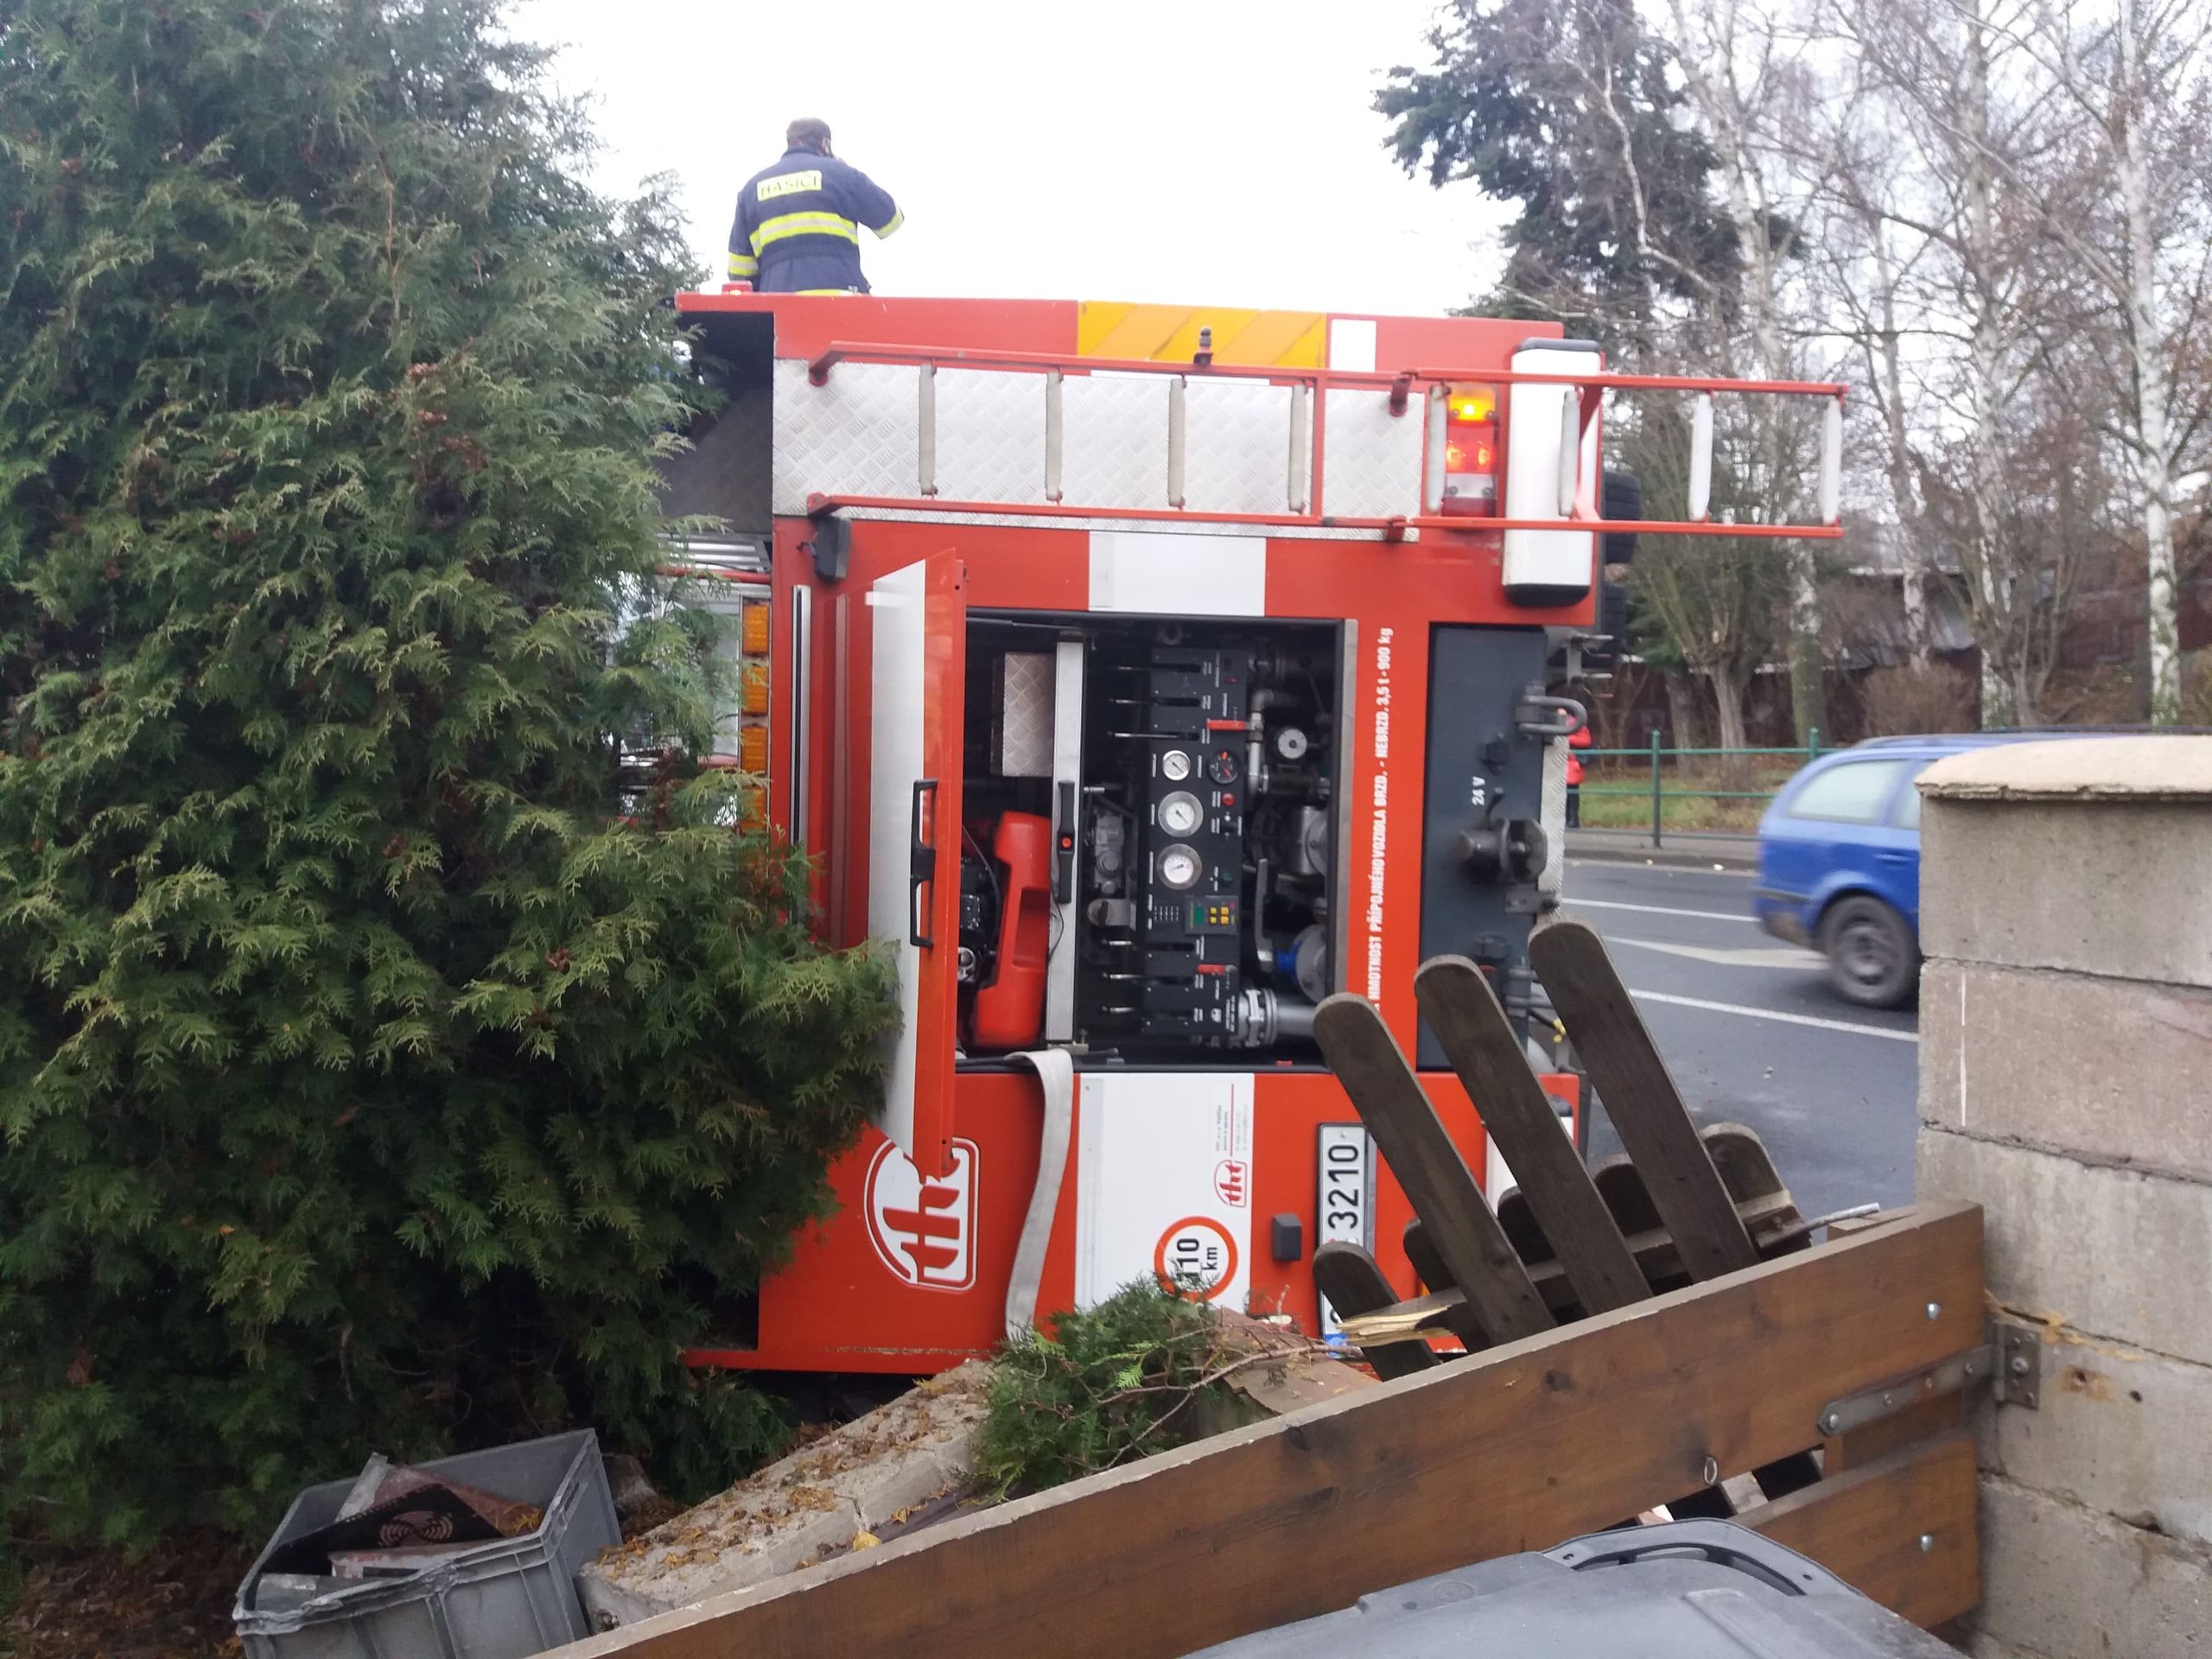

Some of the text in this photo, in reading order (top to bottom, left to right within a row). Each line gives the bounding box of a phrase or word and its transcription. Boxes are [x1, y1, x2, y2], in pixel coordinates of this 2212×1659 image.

[1377, 627, 1394, 644] kg
[1471, 789, 1485, 806] 24
[1327, 1144, 1360, 1230] 3210
[1202, 1246, 1218, 1271] km
